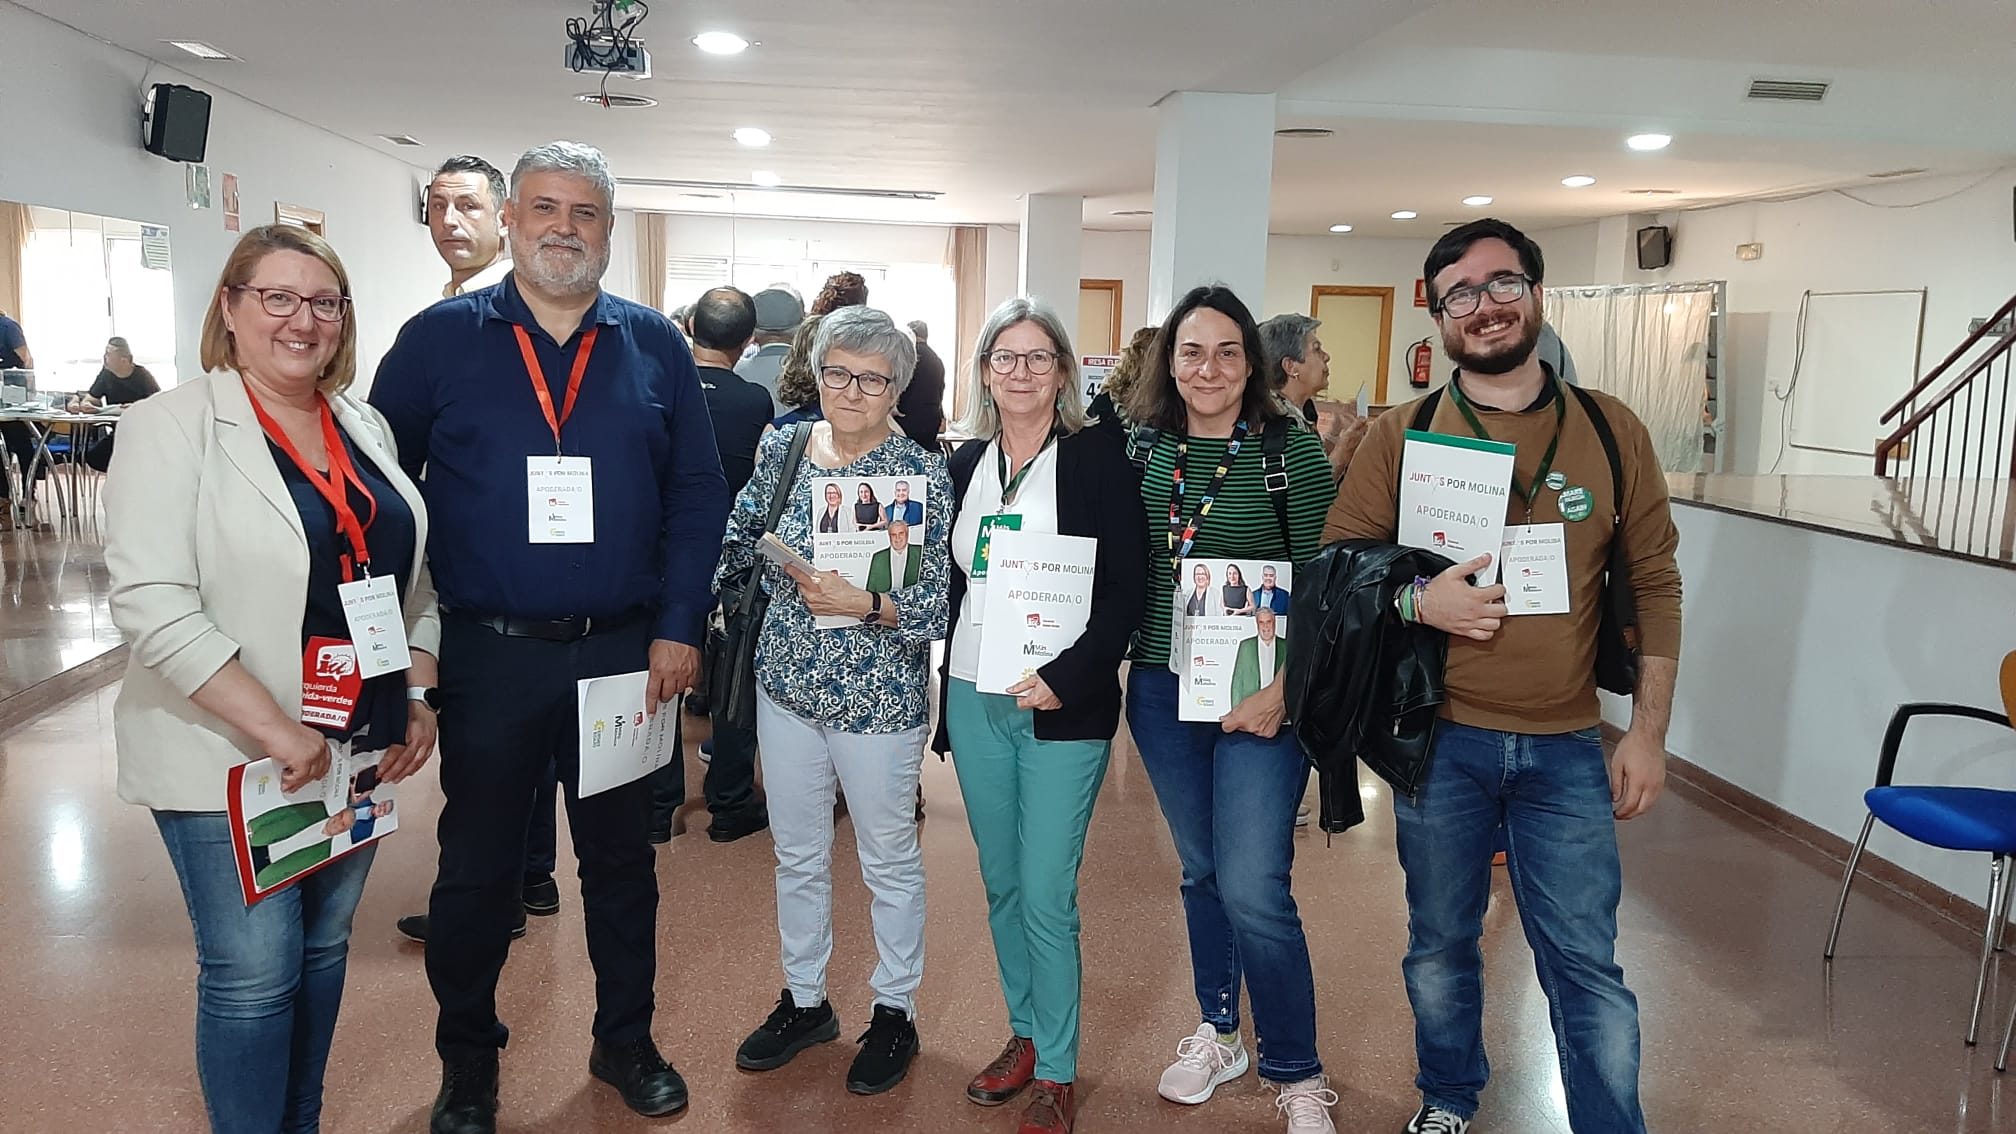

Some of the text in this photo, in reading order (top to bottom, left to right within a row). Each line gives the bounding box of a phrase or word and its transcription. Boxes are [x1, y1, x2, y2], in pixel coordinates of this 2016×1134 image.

[1446, 478, 1466, 491] POR
[1467, 481, 1506, 497] MOLINA
[1041, 562, 1061, 573] POR
[1062, 564, 1095, 576] MOLINA
